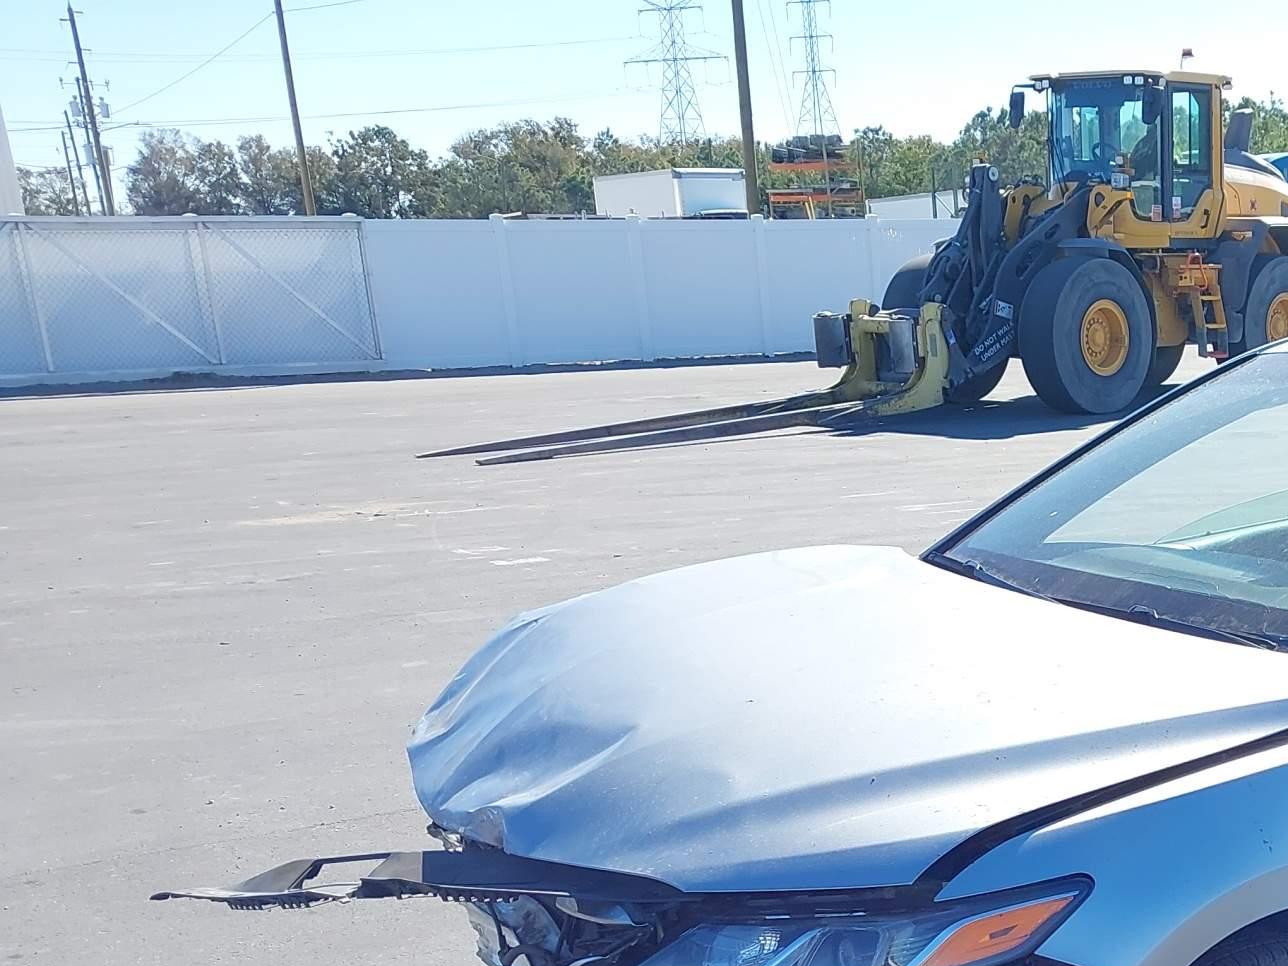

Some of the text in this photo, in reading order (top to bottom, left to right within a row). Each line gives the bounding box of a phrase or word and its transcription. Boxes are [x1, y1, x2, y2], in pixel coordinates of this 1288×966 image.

[974, 344, 984, 355] DO
[984, 332, 997, 348] NOT
[980, 342, 1001, 361] UNDER
